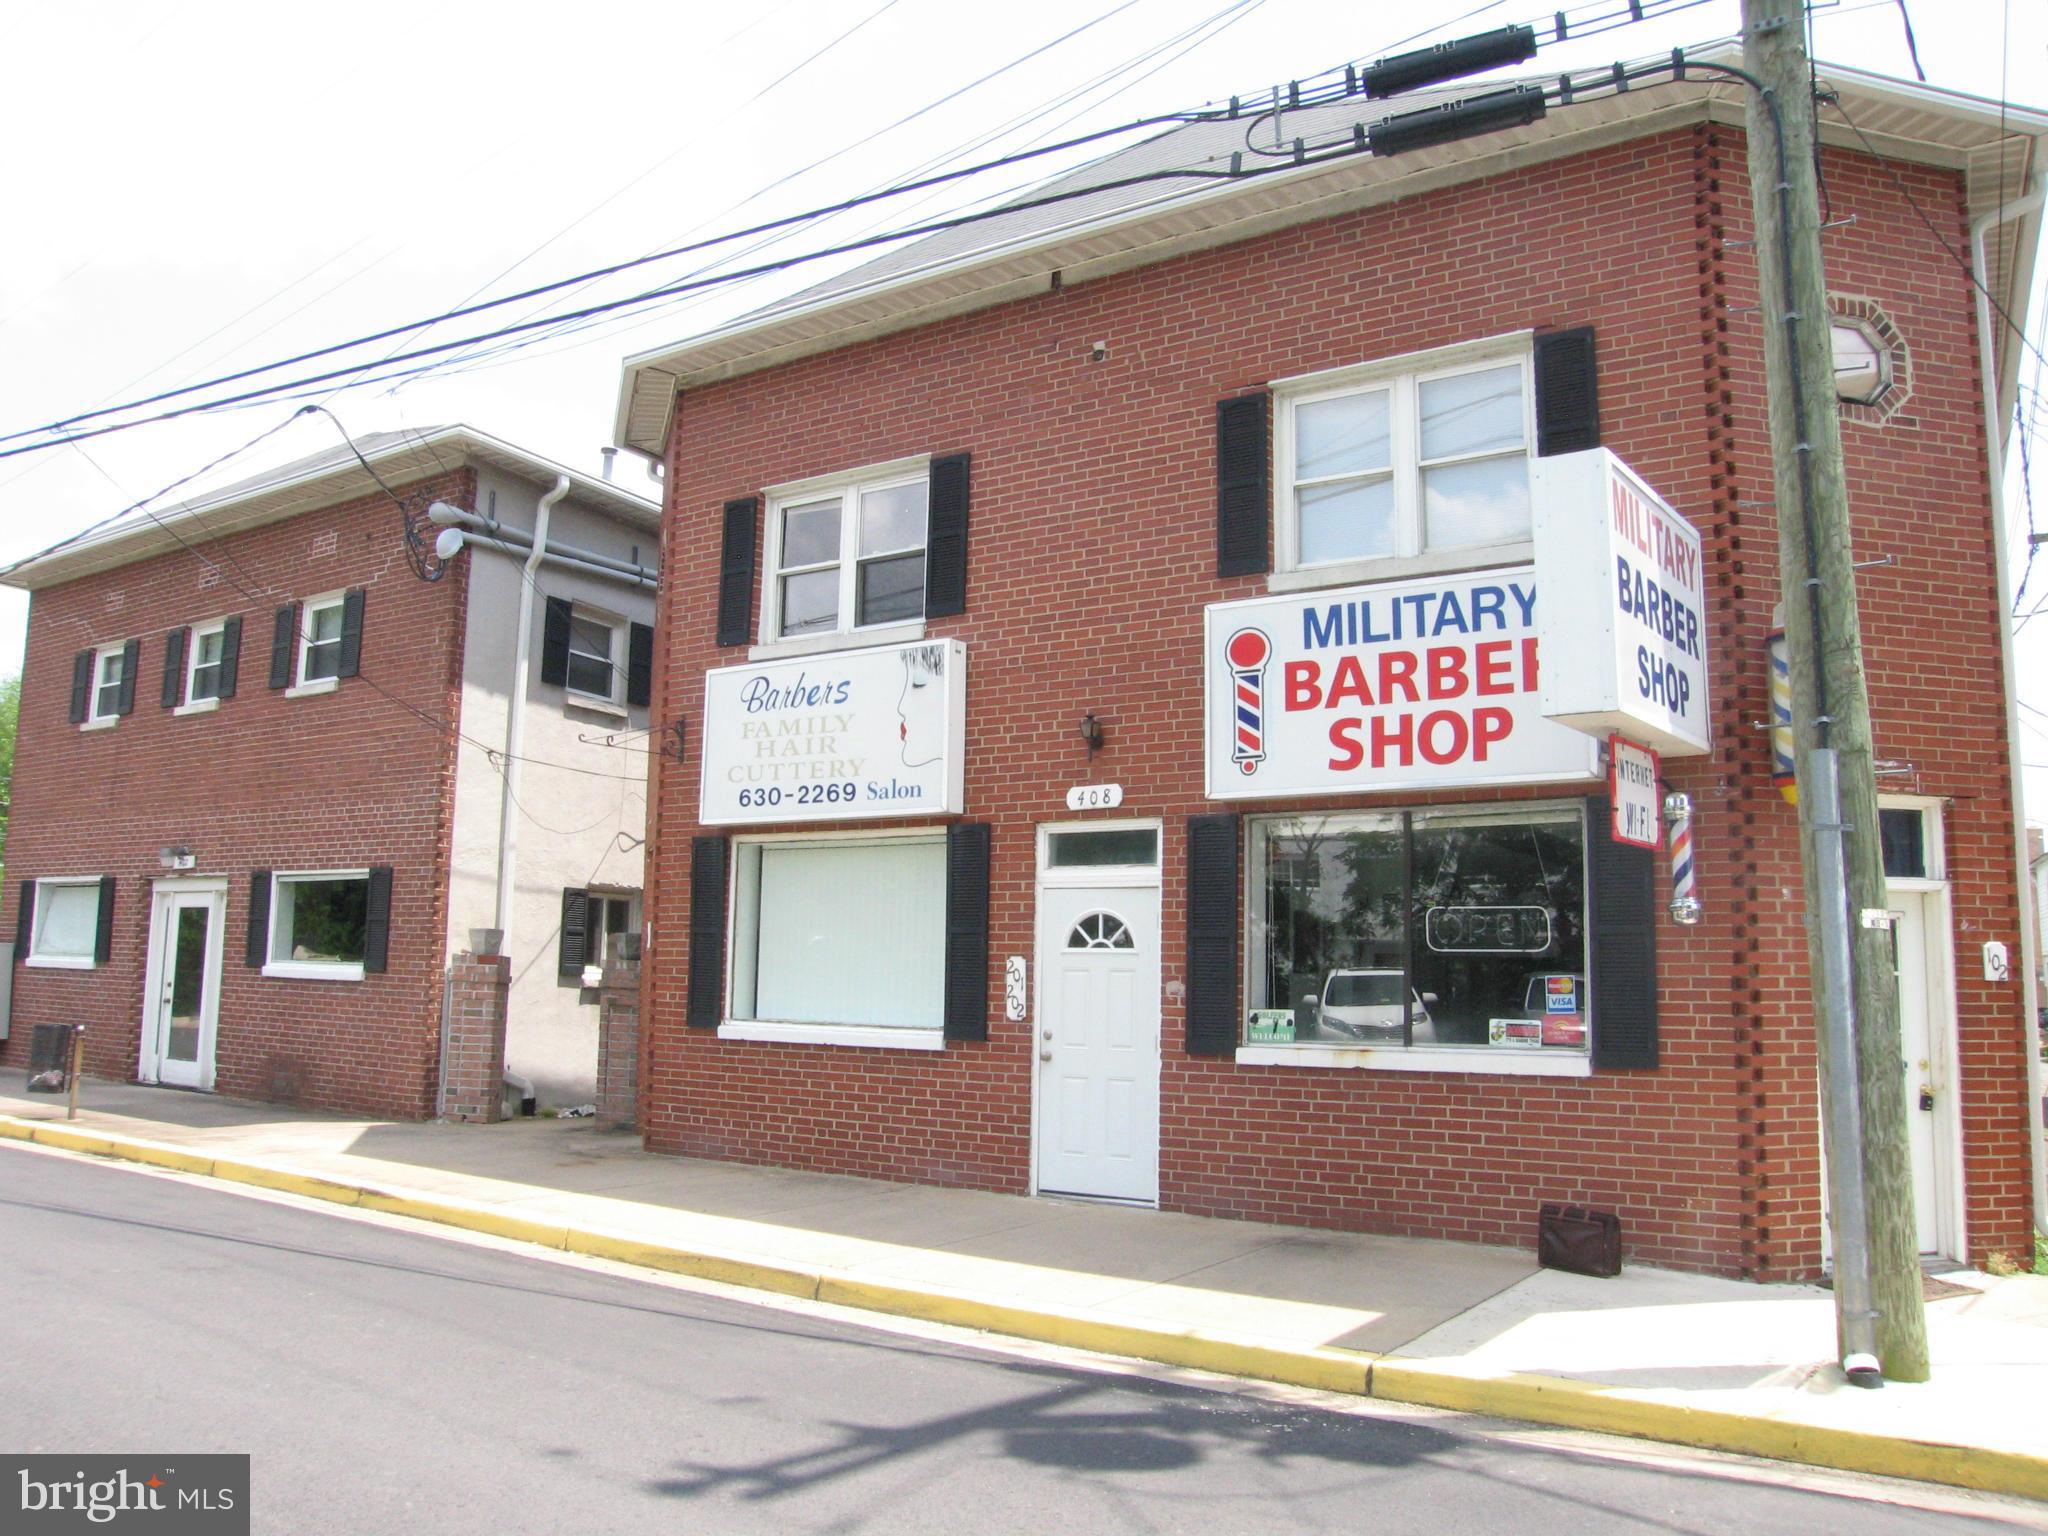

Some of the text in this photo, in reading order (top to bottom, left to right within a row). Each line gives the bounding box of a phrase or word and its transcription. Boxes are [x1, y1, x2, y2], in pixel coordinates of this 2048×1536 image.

[1612, 477, 1698, 593] MILITARY
[1303, 582, 1537, 650] MILITARY
[1616, 554, 1700, 661] BARBER
[740, 672, 851, 714] Barbers
[1637, 644, 1691, 718] SHOP
[741, 713, 856, 740] FAMILY
[1328, 706, 1514, 771] SHOP
[755, 736, 838, 758] HAIR
[727, 758, 867, 784] CUTTERY
[1616, 757, 1654, 789] INTERNET
[739, 779, 922, 807] 630-2269 Salon
[1077, 788, 1111, 806] 408
[1435, 911, 1542, 945] OPEN
[1987, 946, 2008, 980] 102
[1551, 997, 1573, 1006] VISA
